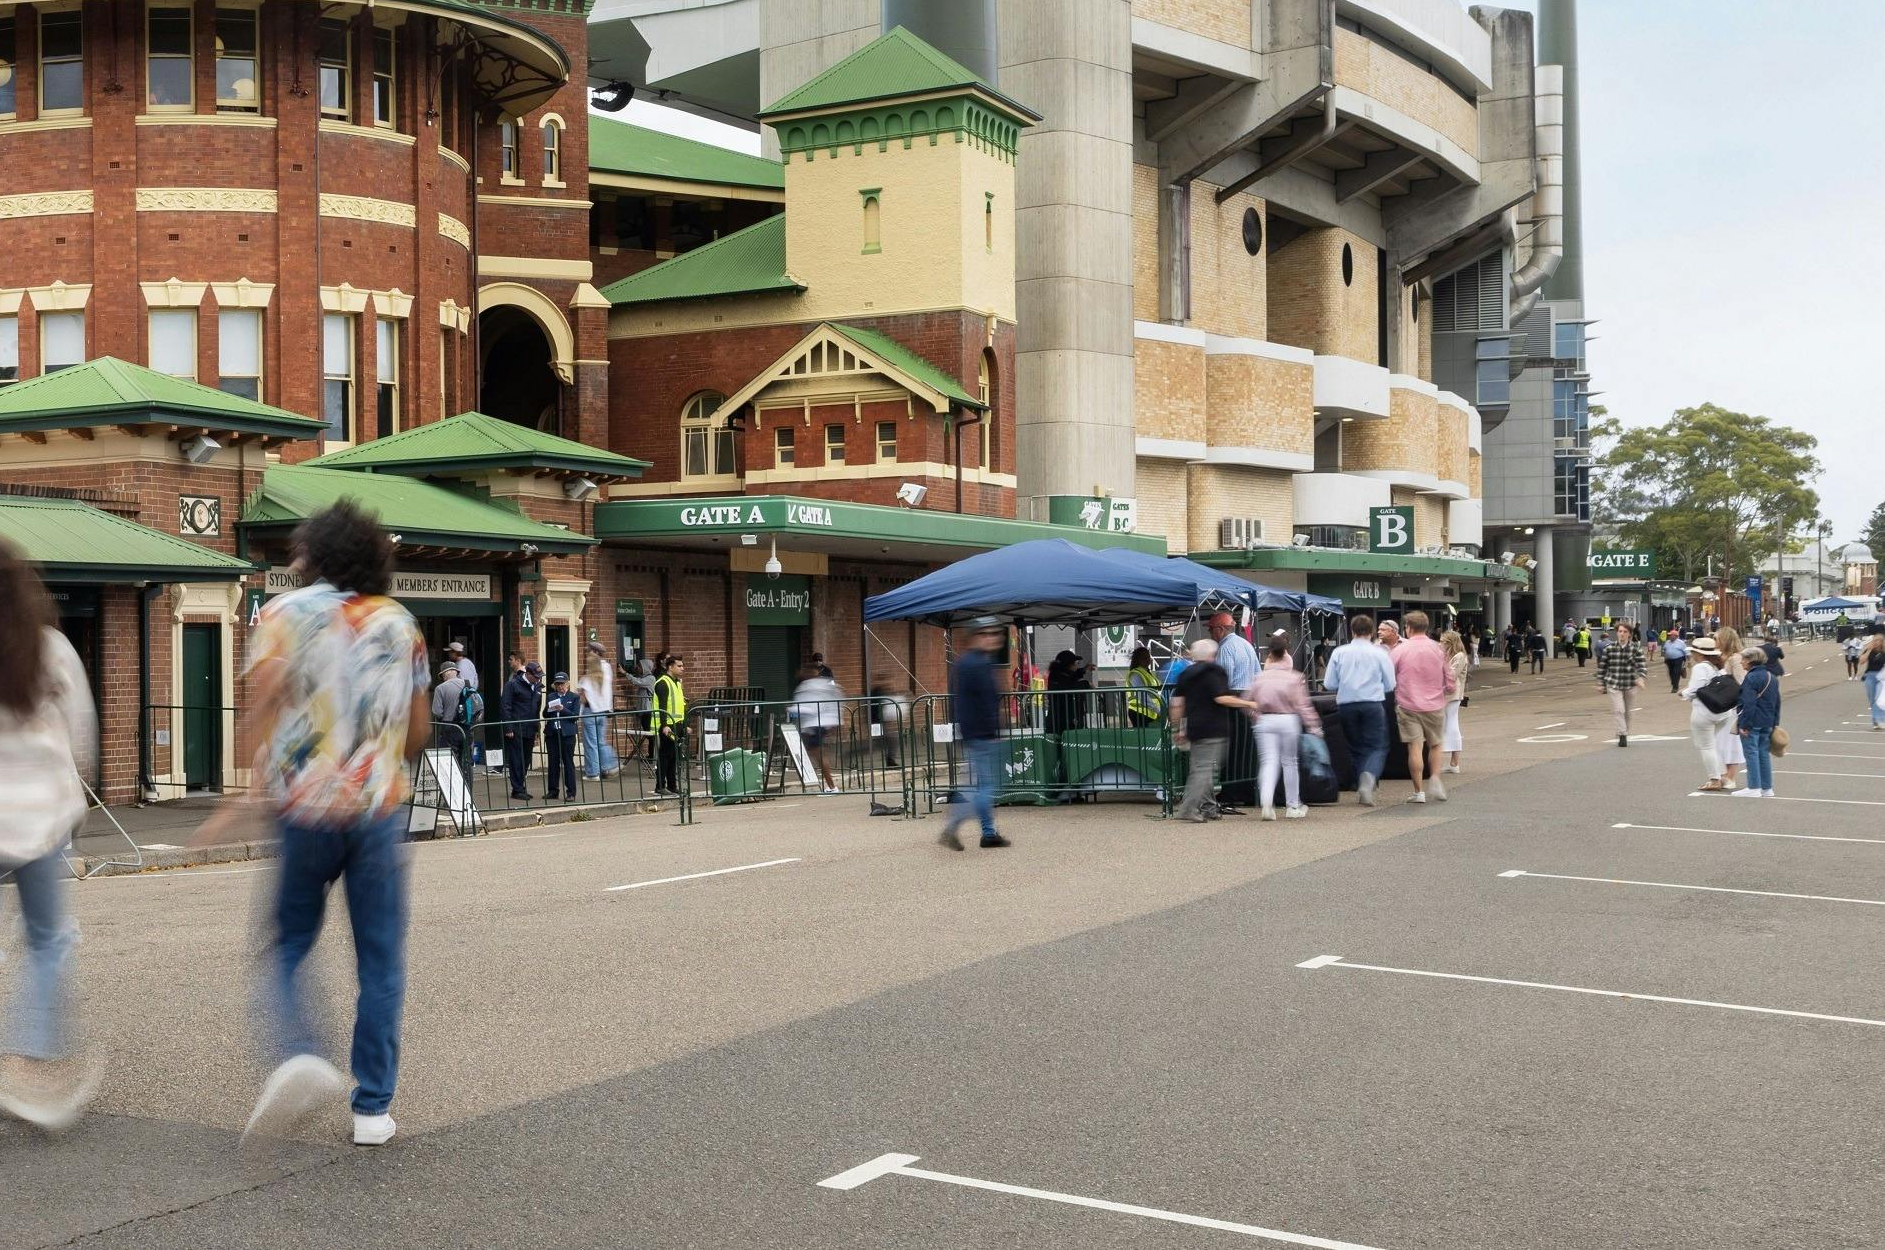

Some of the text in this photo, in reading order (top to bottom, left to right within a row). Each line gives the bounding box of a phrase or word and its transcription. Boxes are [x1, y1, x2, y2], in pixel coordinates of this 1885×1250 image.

[681, 505, 765, 525] GATE A
[799, 505, 832, 526] GATE A
[1376, 514, 1408, 547] B
[1592, 554, 1649, 567] GATE E
[269, 573, 304, 588] SYDNE
[397, 578, 439, 592] MEMBERS'
[441, 579, 487, 593] ENTRANCE
[1354, 581, 1379, 598] GATE B
[747, 589, 766, 608] Gate
[767, 590, 775, 607] A
[780, 590, 804, 613] Entry
[804, 590, 810, 608] 2
[249, 600, 262, 626] A
[522, 605, 533, 627] A
